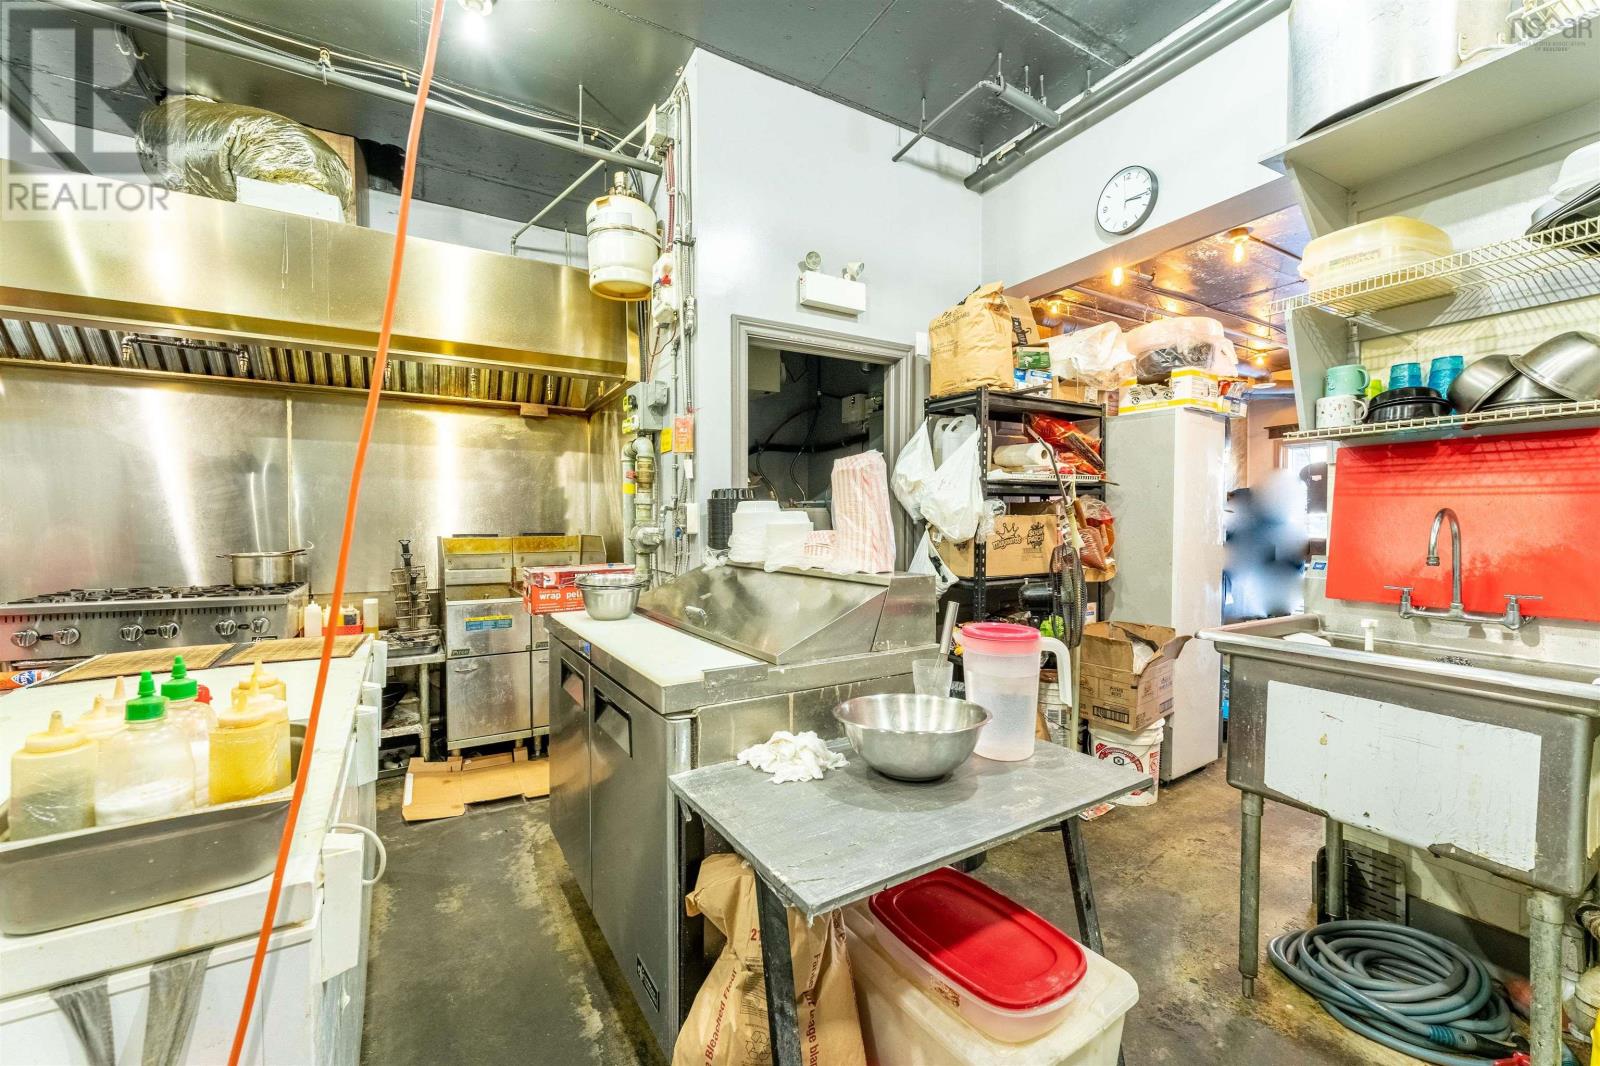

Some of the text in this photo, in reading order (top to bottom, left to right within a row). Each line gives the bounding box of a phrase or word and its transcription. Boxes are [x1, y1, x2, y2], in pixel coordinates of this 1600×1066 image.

[539, 592, 562, 601] wrap
[704, 1000, 727, 1062] Bleached
[723, 967, 738, 1001] Flour
